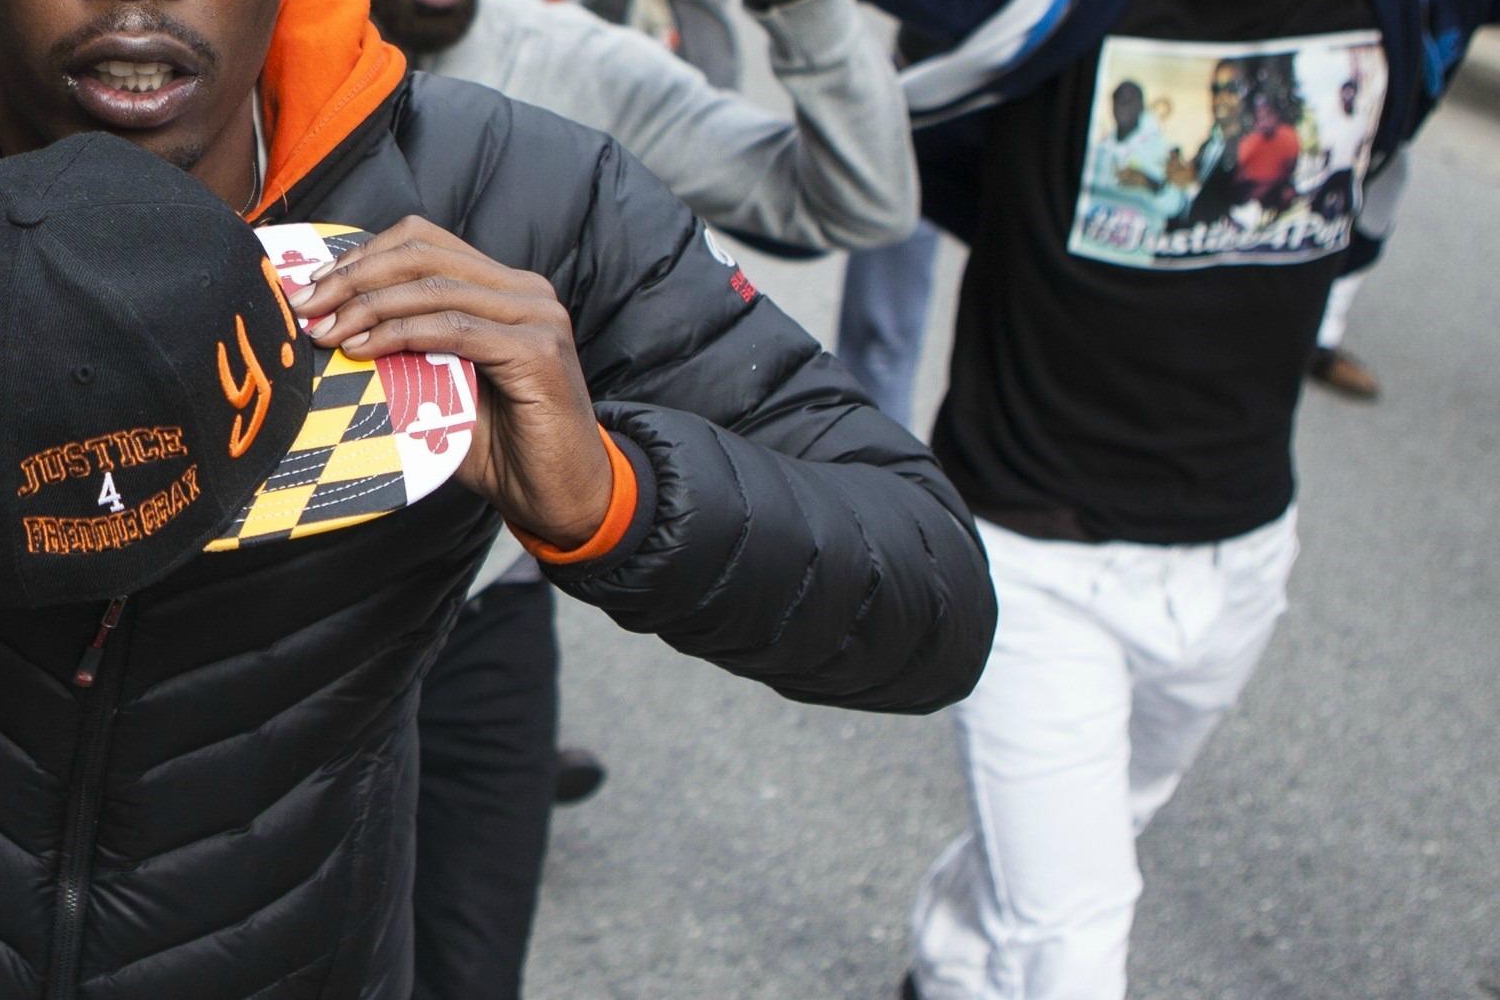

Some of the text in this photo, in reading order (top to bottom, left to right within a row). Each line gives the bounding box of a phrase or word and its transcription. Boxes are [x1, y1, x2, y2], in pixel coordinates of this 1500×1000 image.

[17, 426, 189, 497] JUSTICE
[97, 471, 125, 513] 4
[23, 463, 202, 554] FREDDIE GRAY
